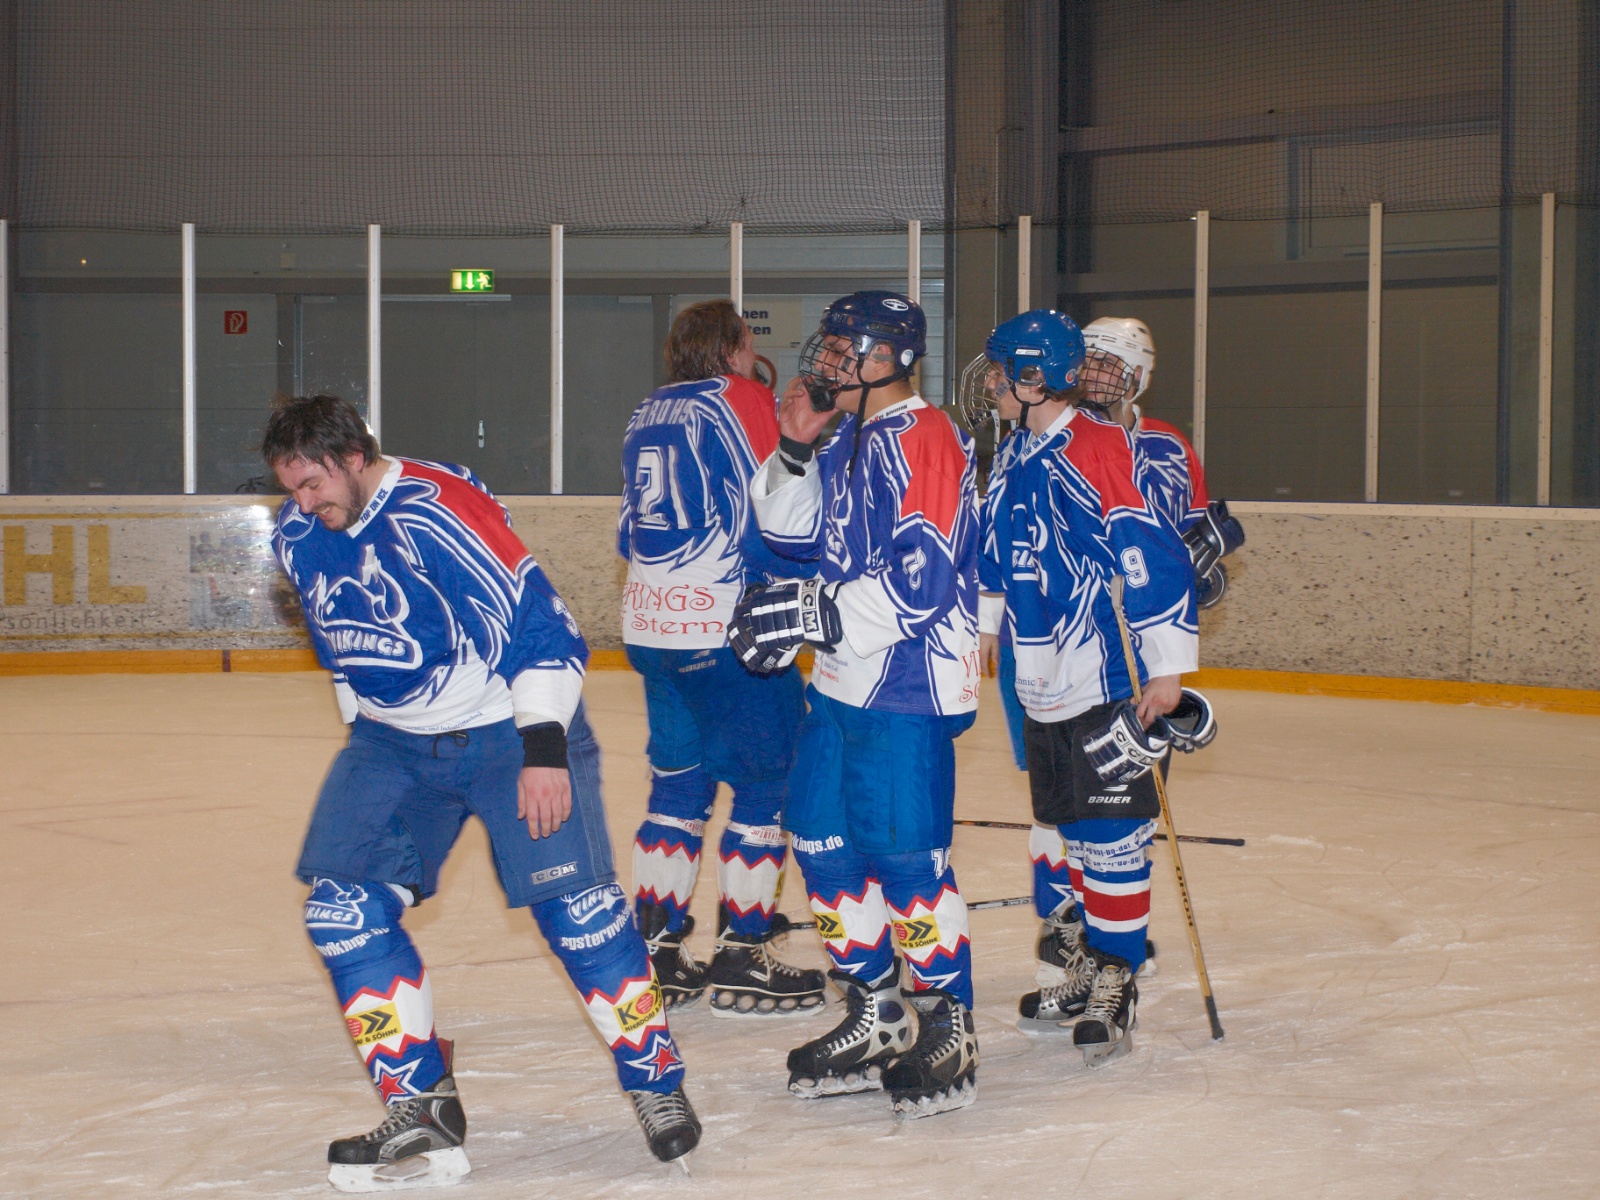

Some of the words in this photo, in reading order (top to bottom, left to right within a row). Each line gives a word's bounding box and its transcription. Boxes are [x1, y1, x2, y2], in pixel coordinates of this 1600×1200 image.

[360, 509, 371, 523] TOP
[370, 499, 380, 511] ON
[376, 488, 389, 501] ICE
[1121, 546, 1149, 588] 9
[803, 579, 819, 633] CCM
[631, 613, 724, 635] Stern
[327, 629, 406, 656] VIKINGS
[536, 863, 576, 881] CCM
